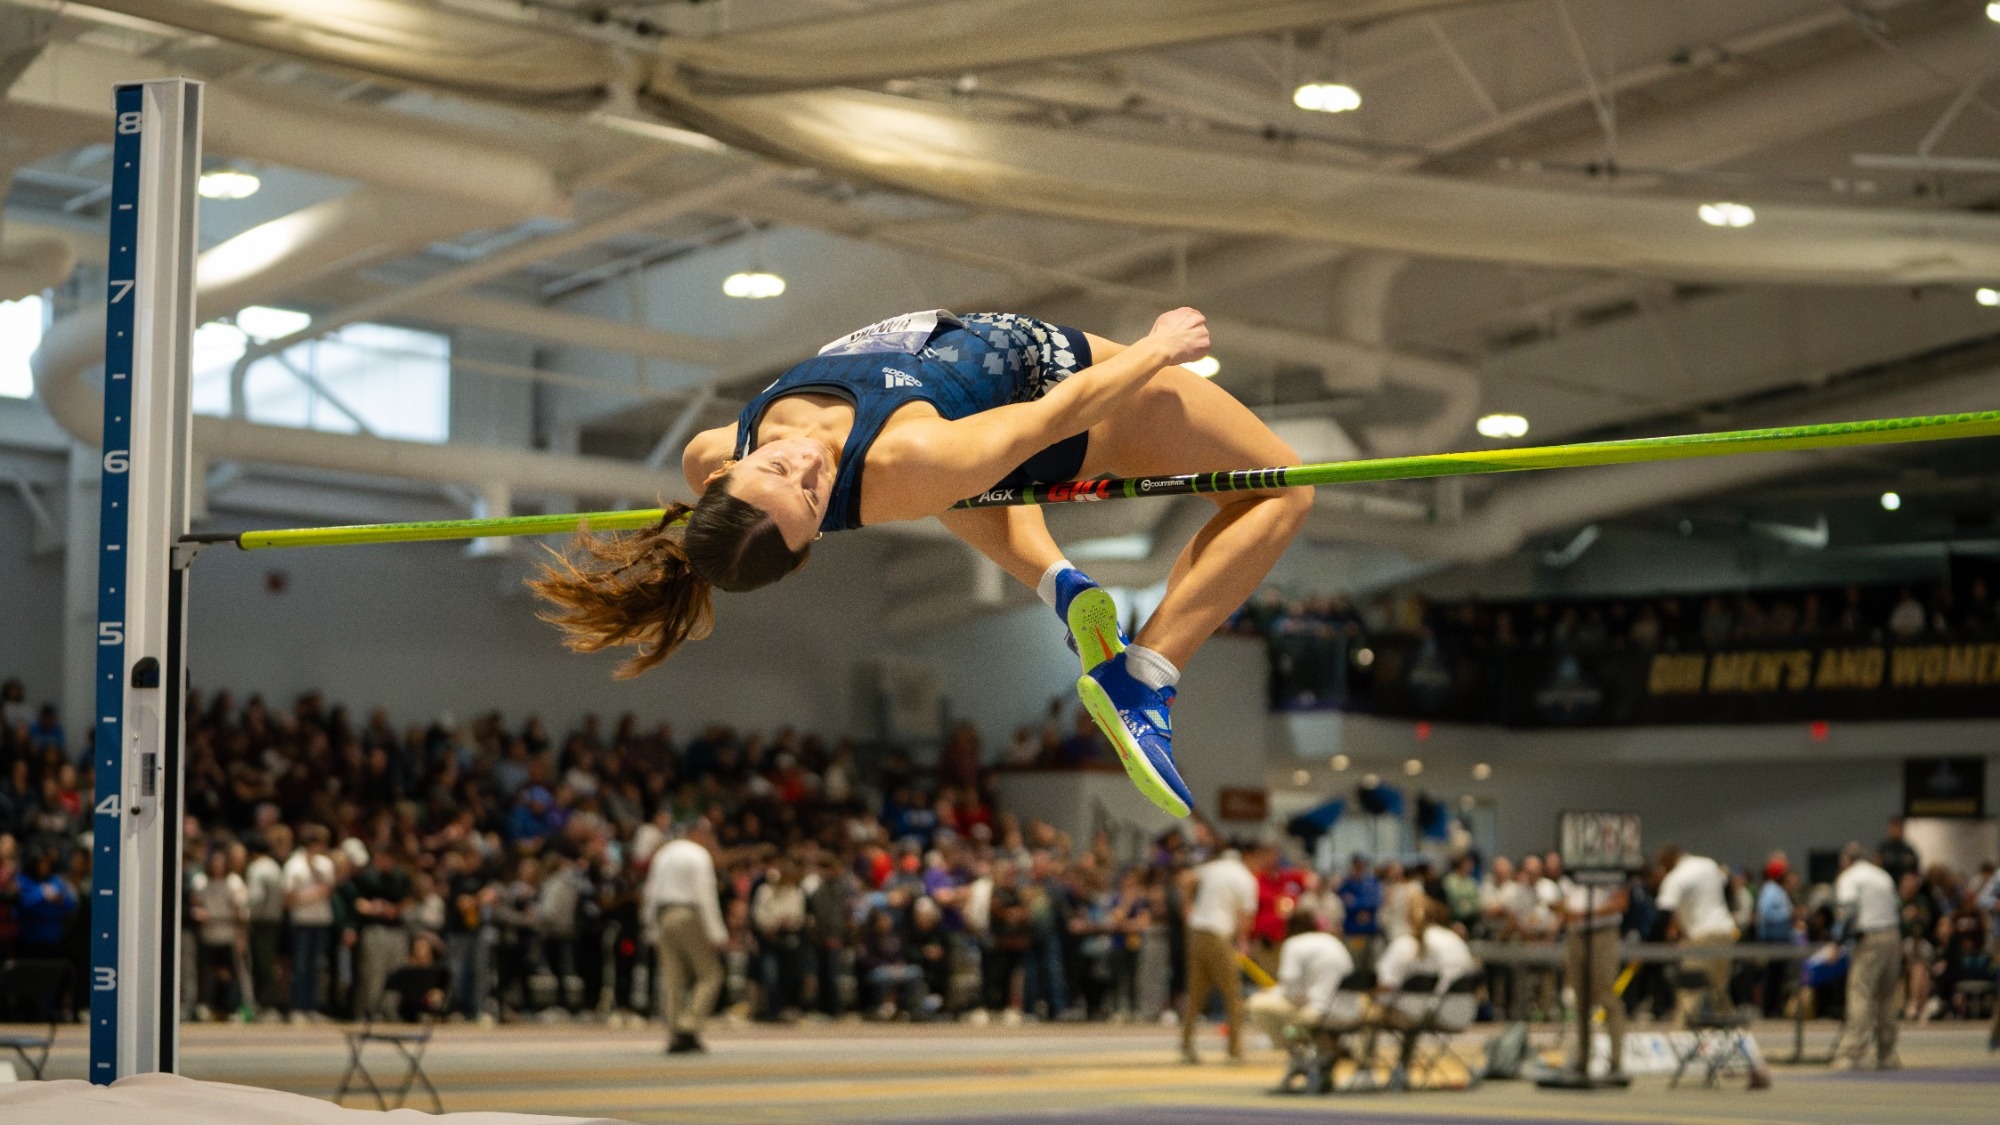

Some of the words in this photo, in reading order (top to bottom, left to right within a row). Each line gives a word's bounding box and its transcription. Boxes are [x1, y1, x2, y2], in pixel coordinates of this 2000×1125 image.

[117, 111, 143, 134] 8
[109, 280, 135, 303] 7
[882, 366, 923, 388] adidas
[103, 450, 130, 473] 6
[978, 488, 1015, 503] AGX
[98, 621, 124, 646] 5
[1816, 647, 1885, 689] AND
[94, 794, 122, 818] 4
[93, 966, 117, 991] 3
